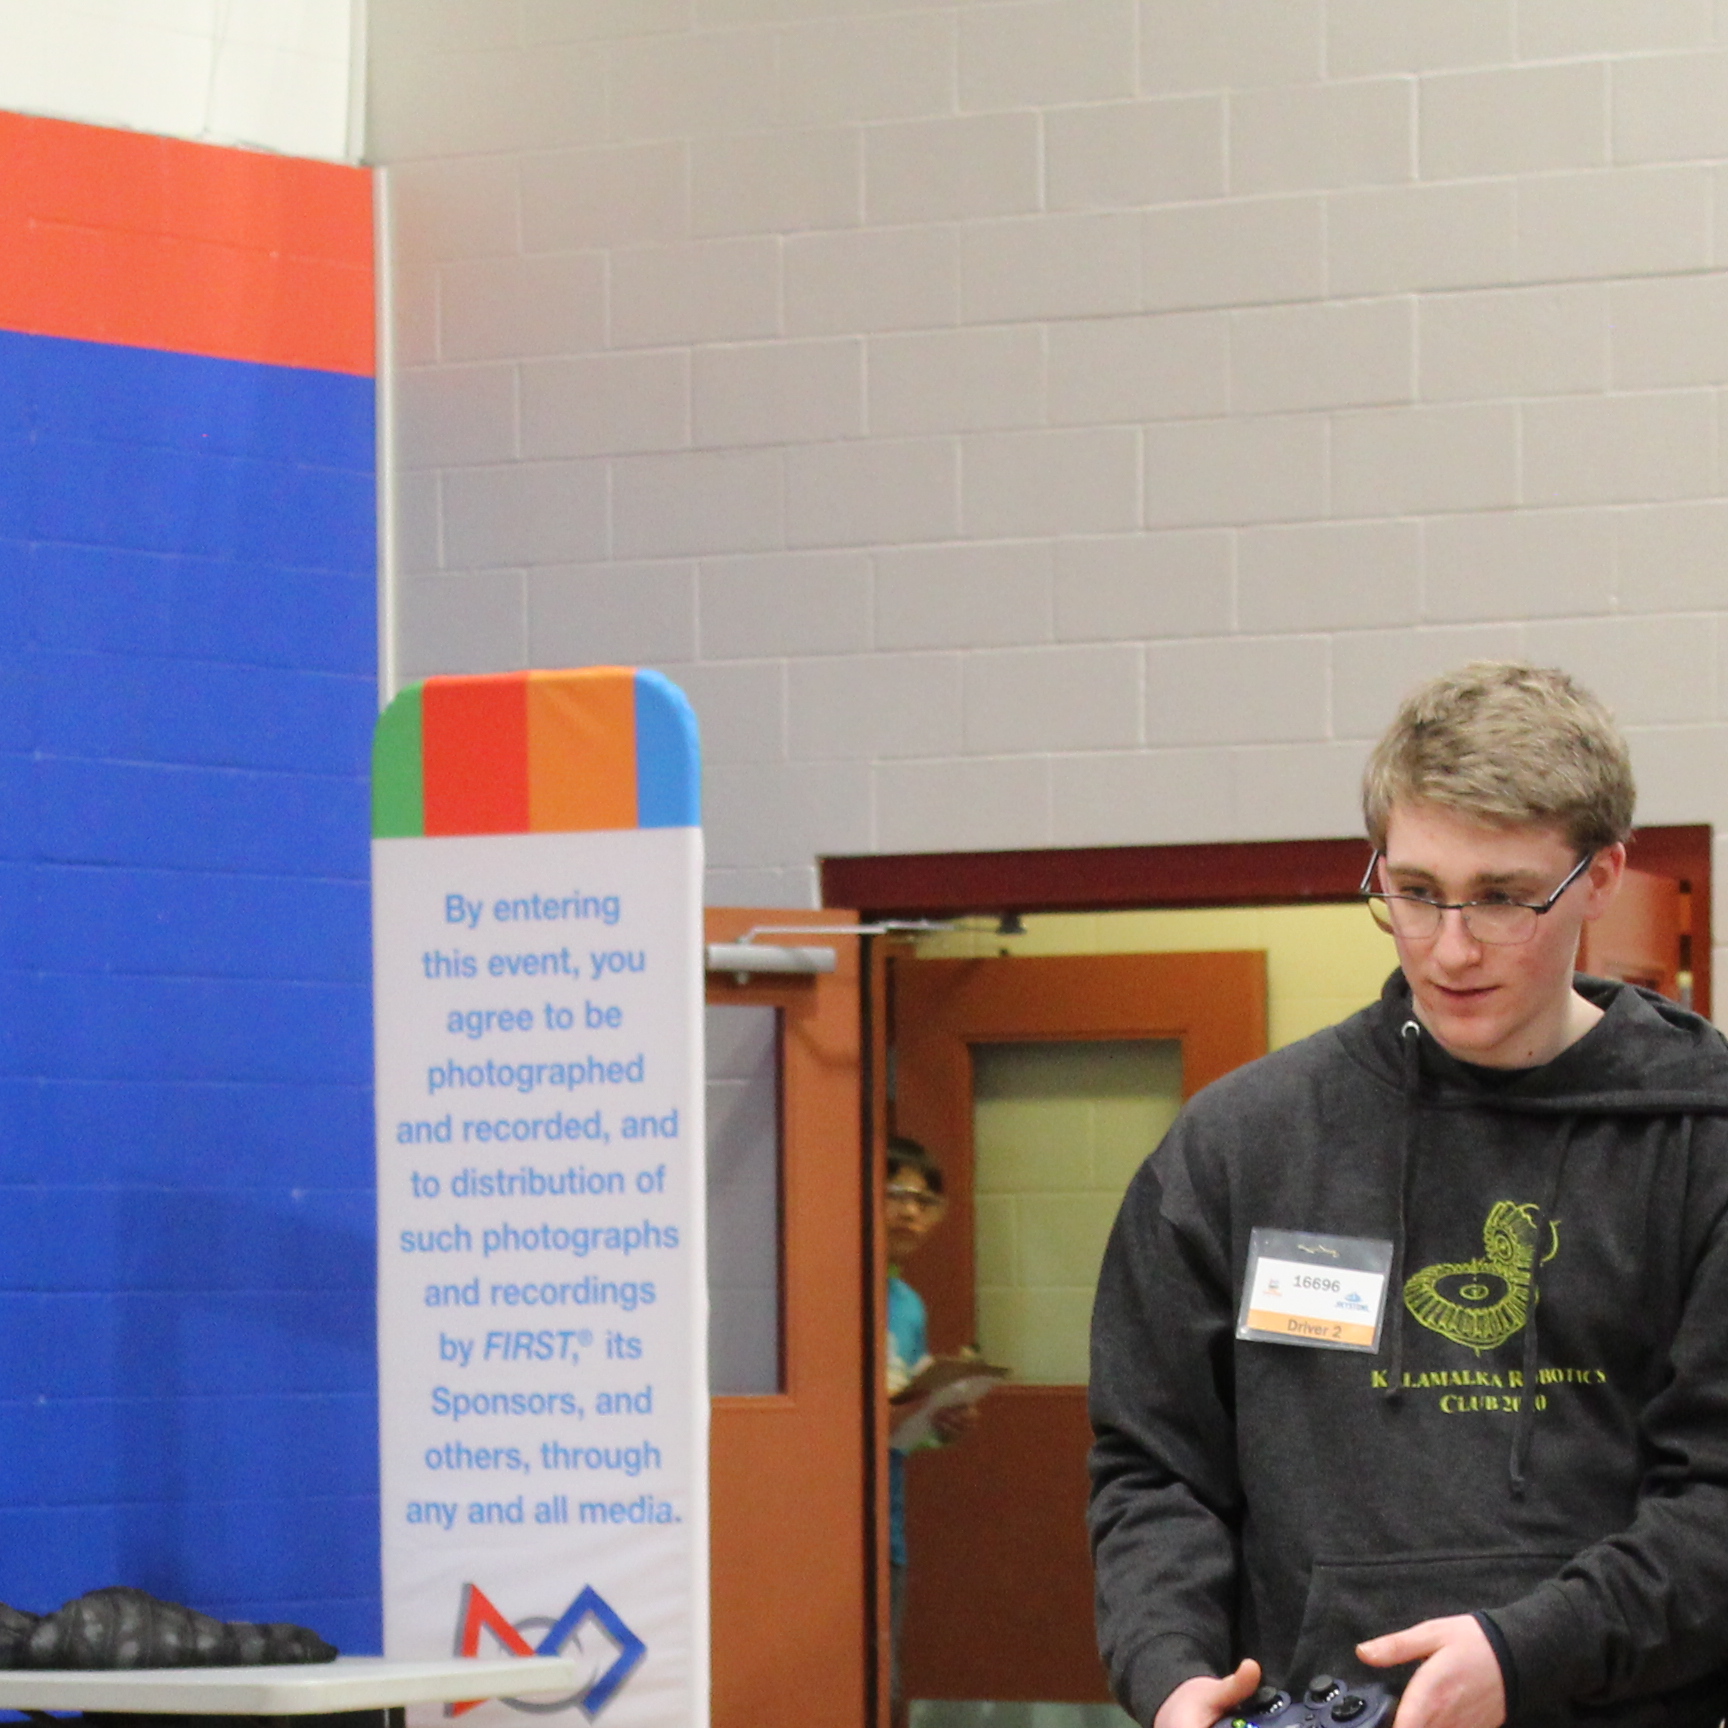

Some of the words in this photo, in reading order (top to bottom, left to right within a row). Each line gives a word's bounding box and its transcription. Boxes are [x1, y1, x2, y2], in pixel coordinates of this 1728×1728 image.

[446, 894, 481, 928] By
[493, 891, 621, 924] entering
[422, 949, 477, 978] this
[488, 948, 580, 978] event,
[590, 949, 645, 980] you
[447, 1007, 533, 1038] agree
[544, 1003, 574, 1031] to
[585, 1001, 623, 1029] be
[428, 1053, 644, 1095] photographed
[396, 1114, 452, 1144] and
[463, 1111, 610, 1145] recorded,
[621, 1109, 678, 1139] and
[411, 1170, 440, 1198] to
[451, 1165, 625, 1197] distribution
[636, 1164, 666, 1193] of
[400, 1223, 472, 1253] such
[483, 1220, 679, 1257] photographs
[425, 1278, 480, 1307] and
[491, 1275, 656, 1311] recordings
[1293, 1275, 1341, 1293] 16696
[1287, 1319, 1329, 1336] Driver
[1332, 1325, 1342, 1339] 2
[440, 1333, 474, 1367] by
[606, 1331, 642, 1360] its
[1371, 1369, 1503, 1389] KLAMALKA
[1508, 1368, 1607, 1389] RBOTICS
[431, 1386, 585, 1421] Sponsors,
[596, 1386, 653, 1415] and
[1438, 1394, 1498, 1414] CLUB
[425, 1442, 530, 1474] others,
[541, 1440, 662, 1477] through
[406, 1499, 458, 1530] any
[468, 1496, 524, 1525] and
[535, 1496, 568, 1524] all
[579, 1495, 682, 1525] media.
